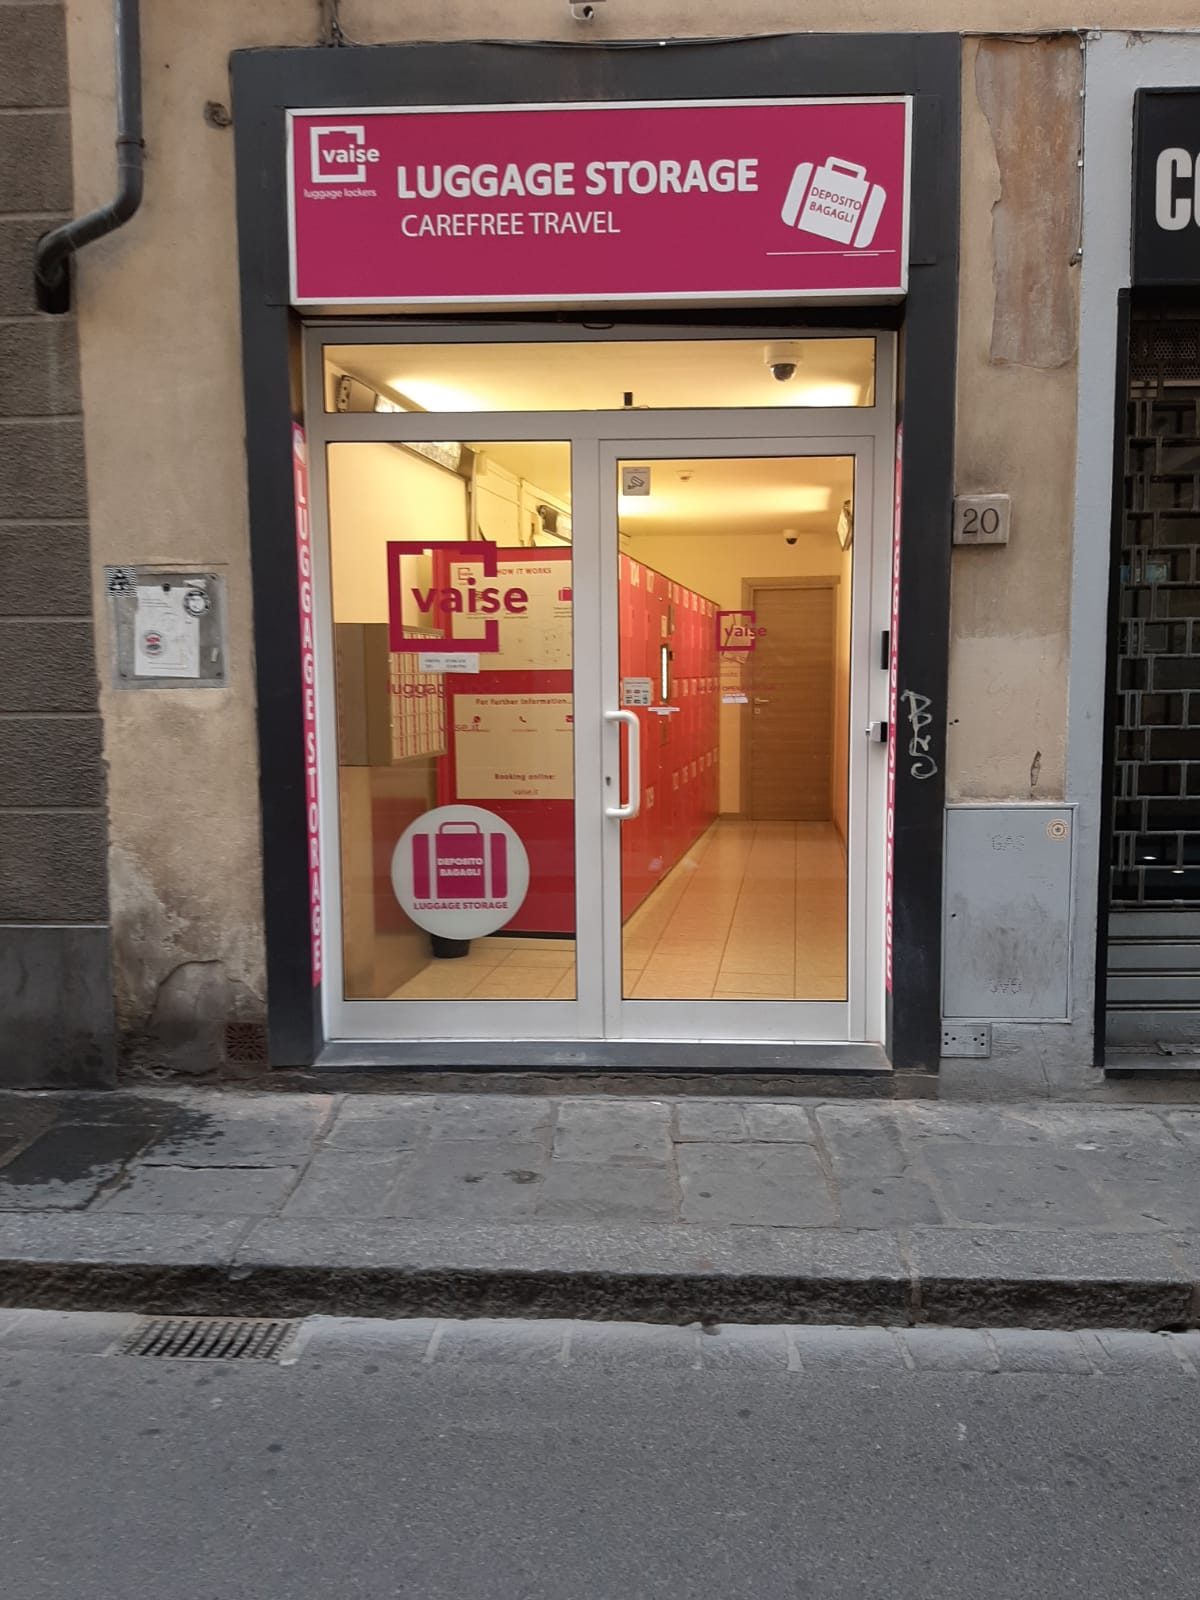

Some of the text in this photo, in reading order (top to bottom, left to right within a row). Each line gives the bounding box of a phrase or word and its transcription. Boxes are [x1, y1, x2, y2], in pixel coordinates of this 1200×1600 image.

[322, 139, 380, 163] vaise
[397, 159, 758, 199] LUGGAGE STORAGE
[1155, 147, 1200, 231] C
[304, 188, 377, 200] luggage lockers
[811, 187, 861, 210] DEPOSITO
[809, 201, 855, 223] BAGAGLI
[401, 211, 621, 237] CAREFREE TRAVEL
[962, 508, 999, 534] 20
[526, 567, 552, 575] WORKS
[411, 577, 529, 614] vaise
[724, 624, 767, 637] vaise
[296, 469, 322, 972] LUGGAGE STORAGE
[437, 857, 483, 866] DEPOSITO
[439, 868, 481, 877] BAGAGLI
[413, 901, 508, 910] LUGGAGE STORAGE
